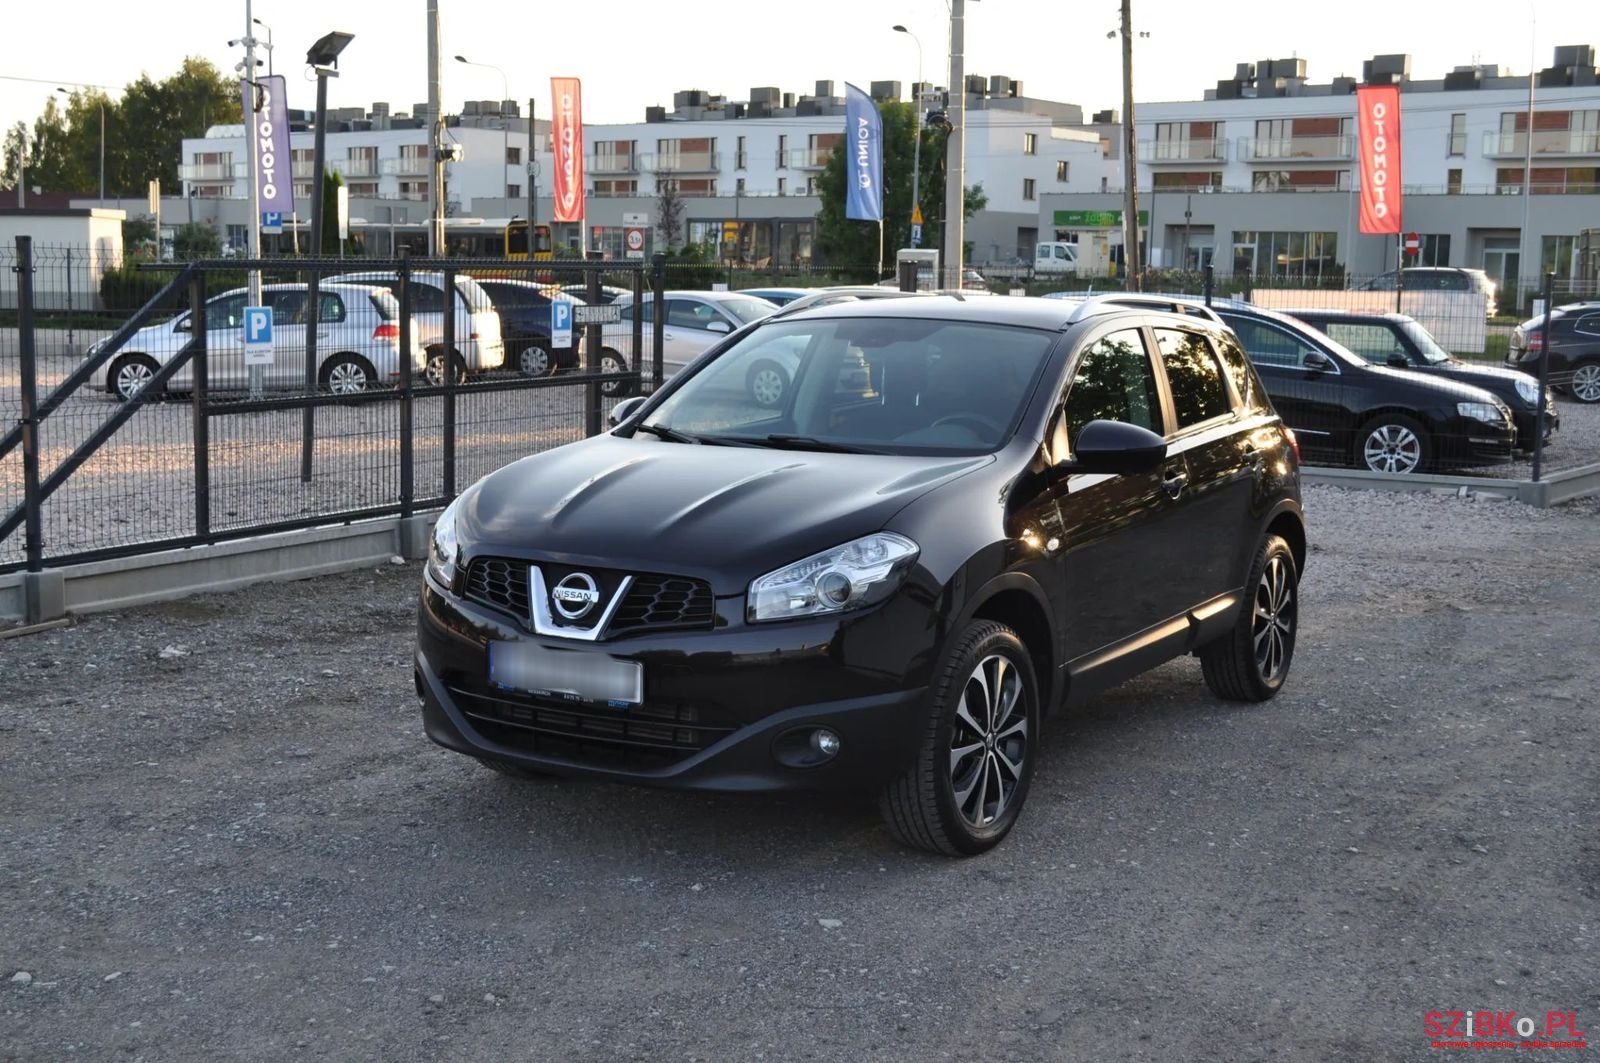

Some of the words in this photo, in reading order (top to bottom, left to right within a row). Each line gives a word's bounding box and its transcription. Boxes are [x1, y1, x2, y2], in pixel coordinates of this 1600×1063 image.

[259, 89, 277, 200] OTOMOTO
[1373, 102, 1387, 219] OTOMOTO
[251, 312, 267, 340] P
[556, 304, 568, 328] P
[554, 588, 592, 600] NISSAN
